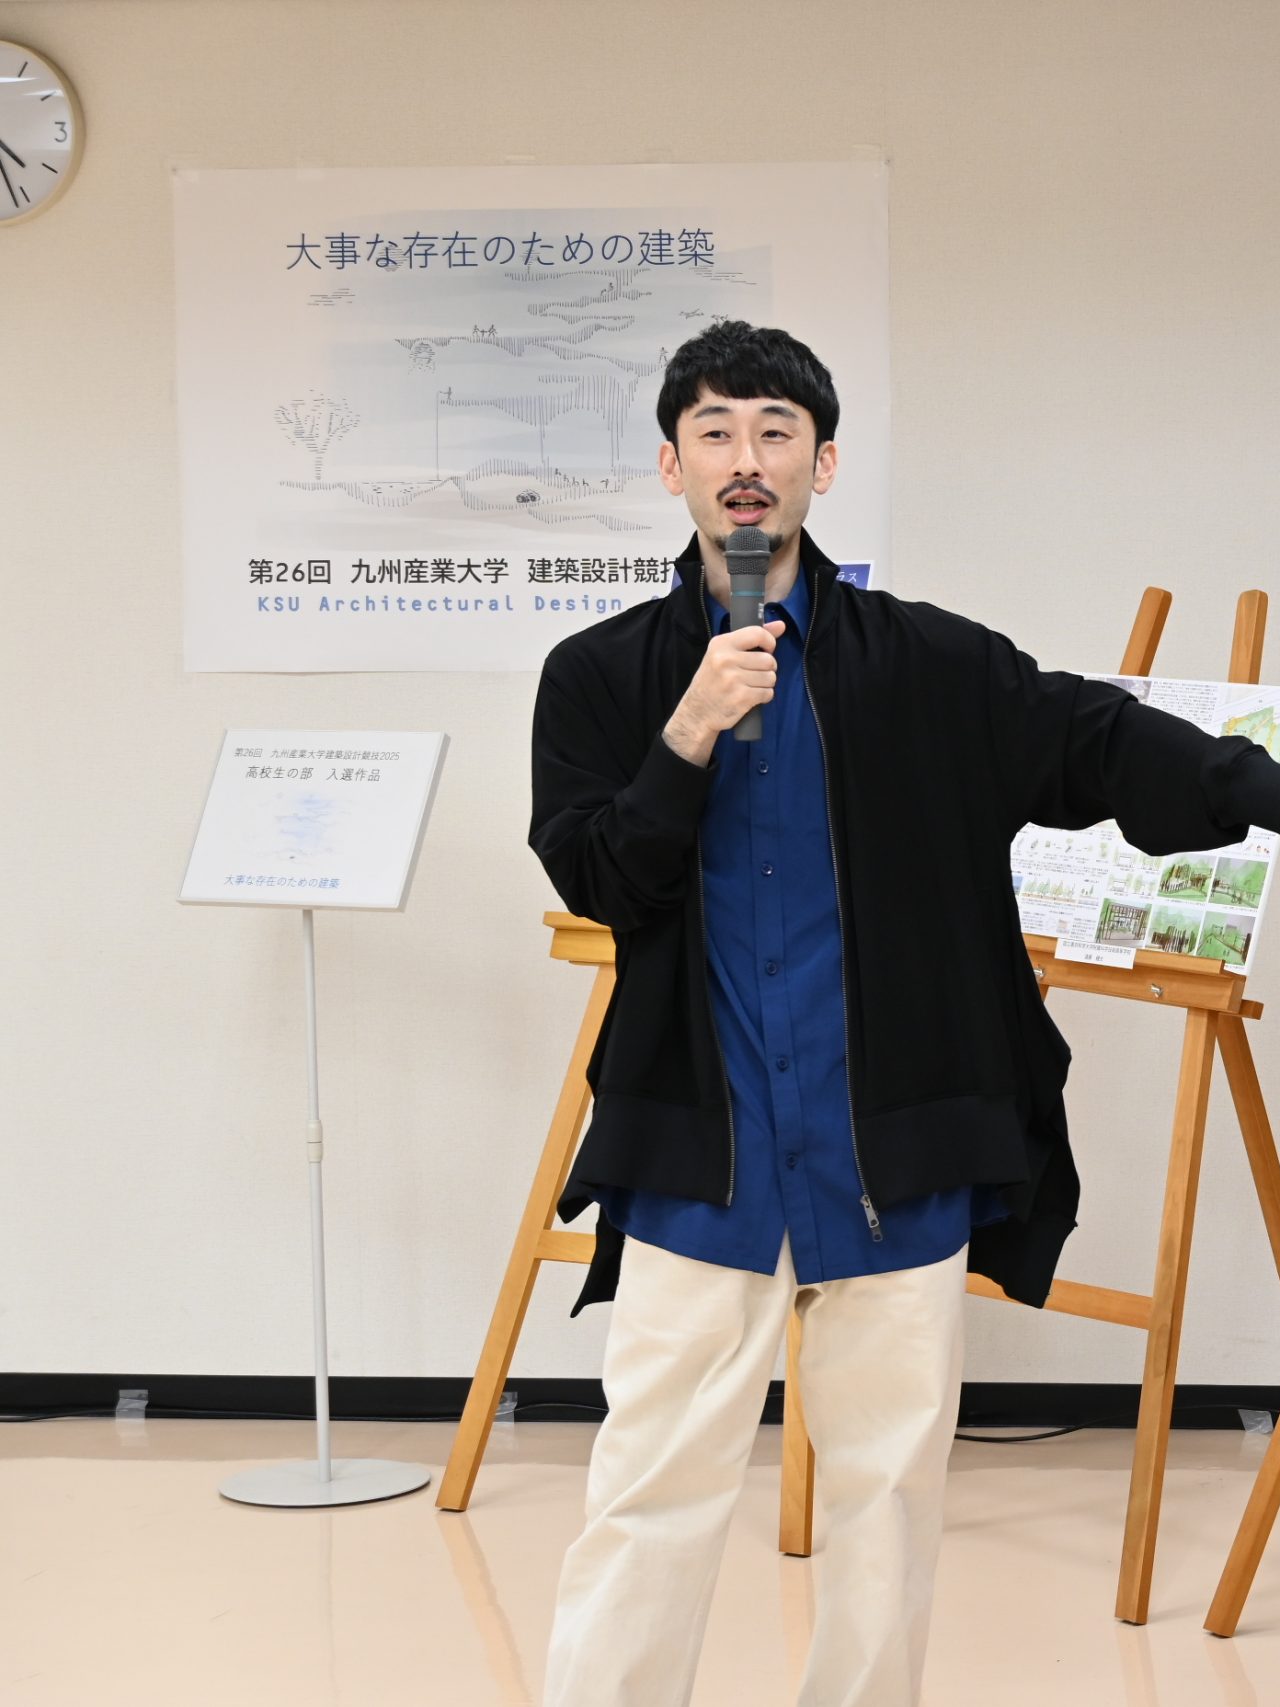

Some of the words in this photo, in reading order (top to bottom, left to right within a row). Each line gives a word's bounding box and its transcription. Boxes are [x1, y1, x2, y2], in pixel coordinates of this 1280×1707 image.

[54, 121, 68, 143] 3
[286, 228, 715, 271] 大事な存在のための建築
[248, 558, 331, 585] 第26回
[351, 558, 509, 584] 九州産業大学
[257, 596, 300, 612] KSU
[318, 595, 514, 612] Architectural
[534, 594, 622, 614] Design
[233, 747, 263, 758] 第26回
[245, 766, 314, 780] 高校生の部
[326, 767, 381, 782] 入選作品
[223, 874, 341, 889] 大事な存在のための建築
